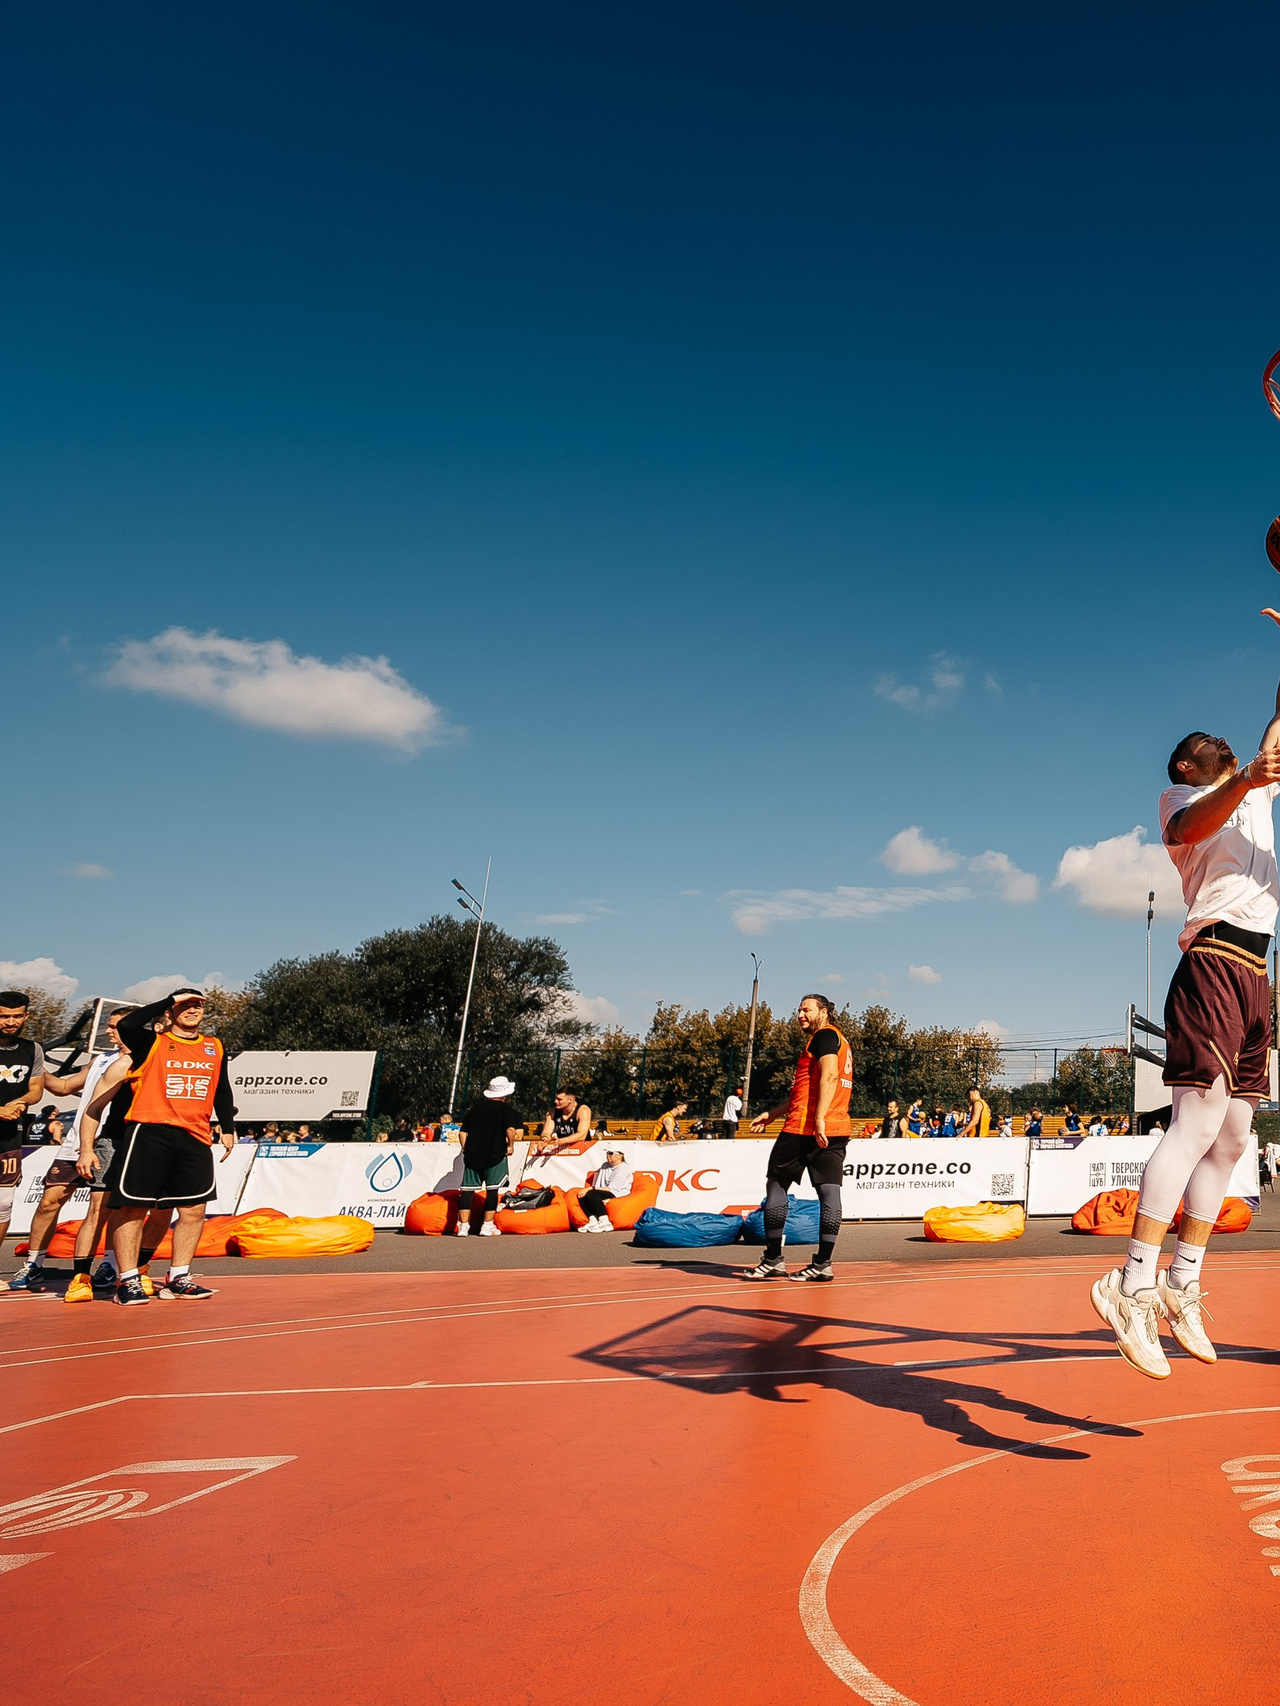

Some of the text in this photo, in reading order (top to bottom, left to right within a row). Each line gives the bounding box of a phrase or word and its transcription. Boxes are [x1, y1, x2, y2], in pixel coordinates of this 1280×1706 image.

[183, 1061, 215, 1071] DKC
[0, 1064, 30, 1084] X3
[234, 1076, 329, 1088] appzone.co
[243, 1088, 316, 1096] магазин техники
[2, 1157, 17, 1174] 10
[842, 1162, 972, 1180] appzone.co
[856, 1179, 955, 1190] магазин техники
[1111, 1174, 1141, 1187] УЛИЧНО
[339, 1203, 406, 1218] АКВА-ЛАЙ
